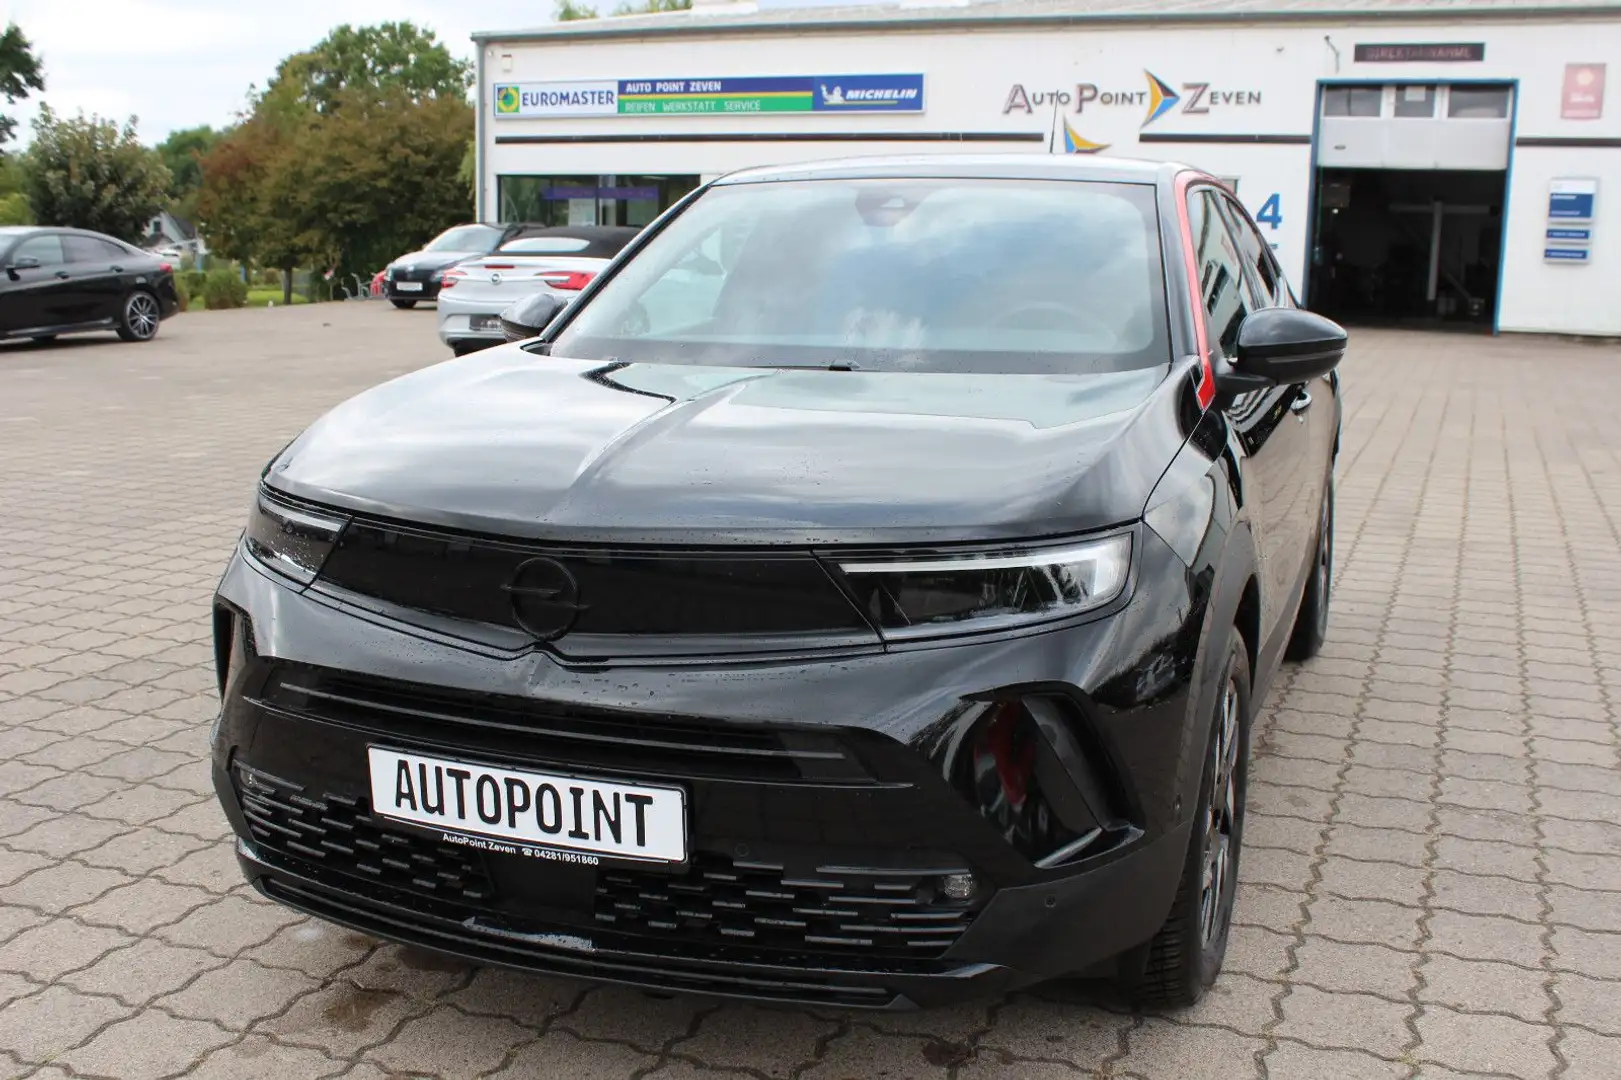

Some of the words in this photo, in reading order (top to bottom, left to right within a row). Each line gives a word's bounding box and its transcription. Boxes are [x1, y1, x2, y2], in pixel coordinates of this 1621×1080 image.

[626, 82, 652, 93] AUTO
[656, 82, 685, 92] POINT
[689, 81, 722, 92] ZEVEN
[845, 88, 918, 100] MICHELIN
[521, 90, 615, 107] EUROMASTER
[625, 101, 656, 113] REIFEN
[662, 100, 717, 112] WERKSTATT
[724, 99, 761, 111] SERVICE
[1256, 193, 1283, 230] 4
[395, 758, 654, 847] AUTOPOINT
[442, 832, 487, 850] AutoPoint
[488, 841, 517, 855] Zeven
[534, 848, 599, 866] 04281/951860
